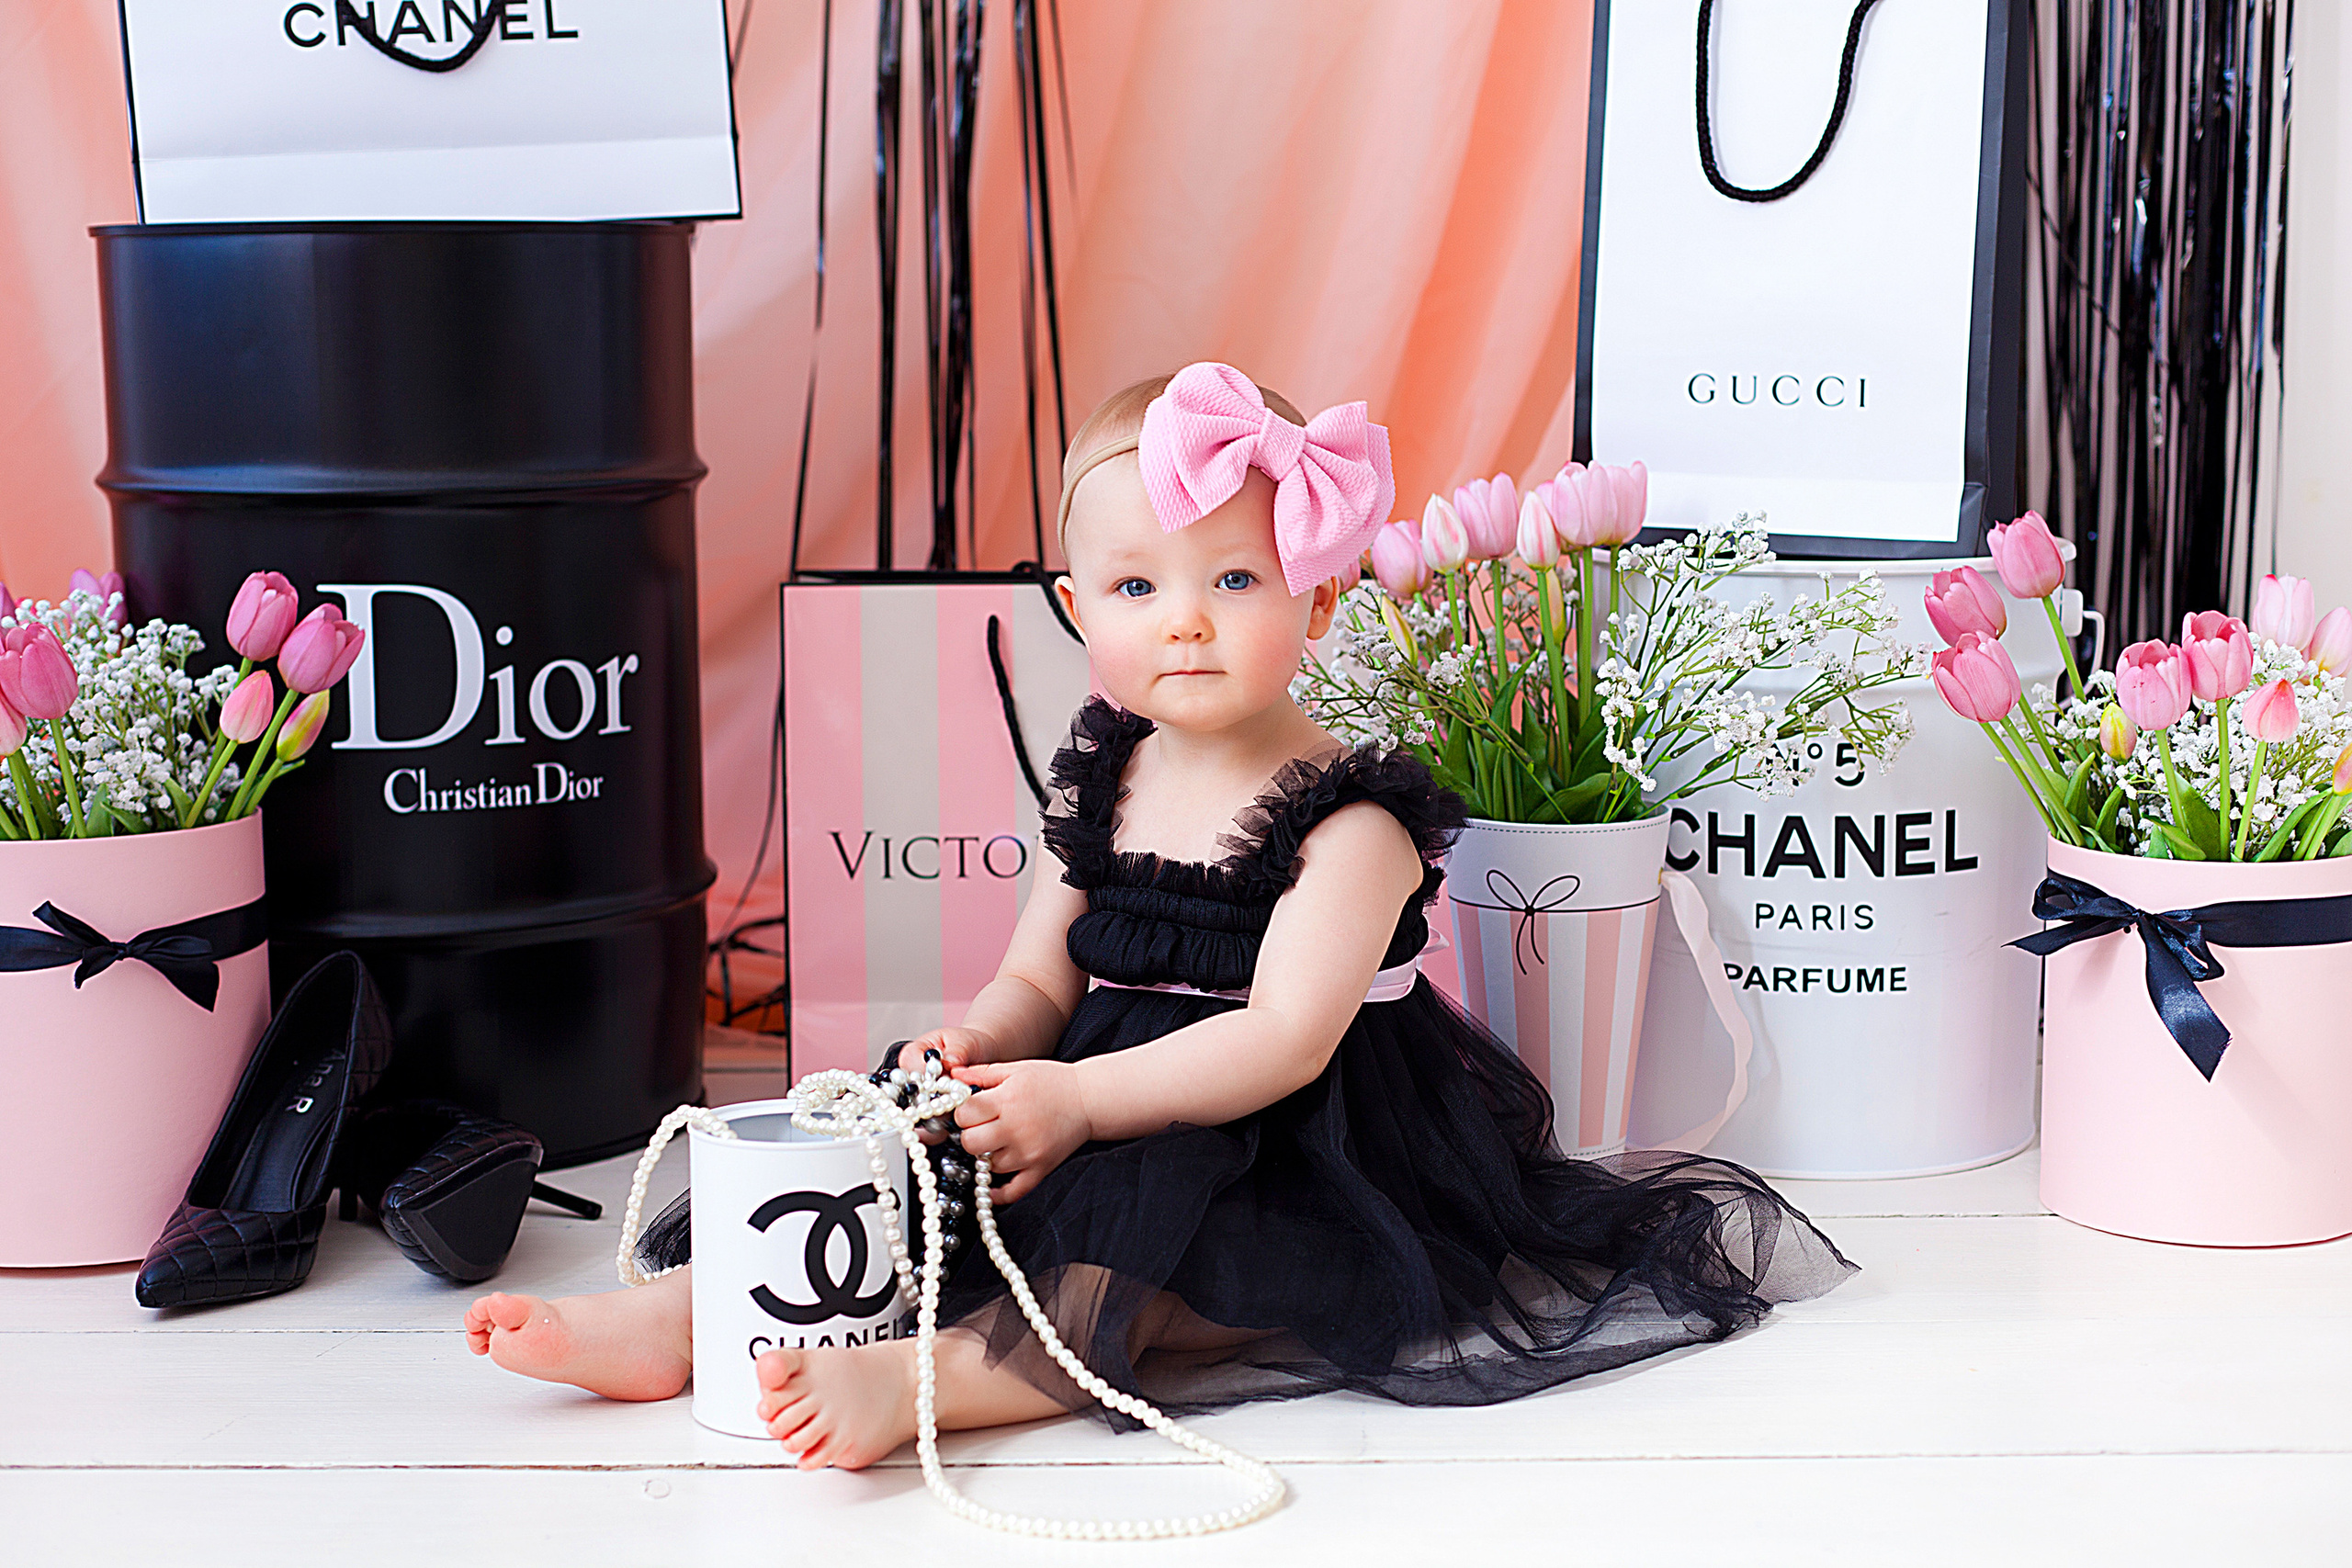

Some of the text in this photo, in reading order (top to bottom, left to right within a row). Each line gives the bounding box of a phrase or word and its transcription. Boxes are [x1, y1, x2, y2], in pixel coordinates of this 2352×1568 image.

[283, 0, 579, 48] CHANEL
[1688, 373, 1865, 408] GUCCI
[316, 584, 639, 750] Dior
[829, 830, 1039, 880] VICTO
[1665, 807, 1979, 879] CHANEL
[1756, 903, 1874, 931] PARIS
[1724, 963, 1907, 994] PARFUME
